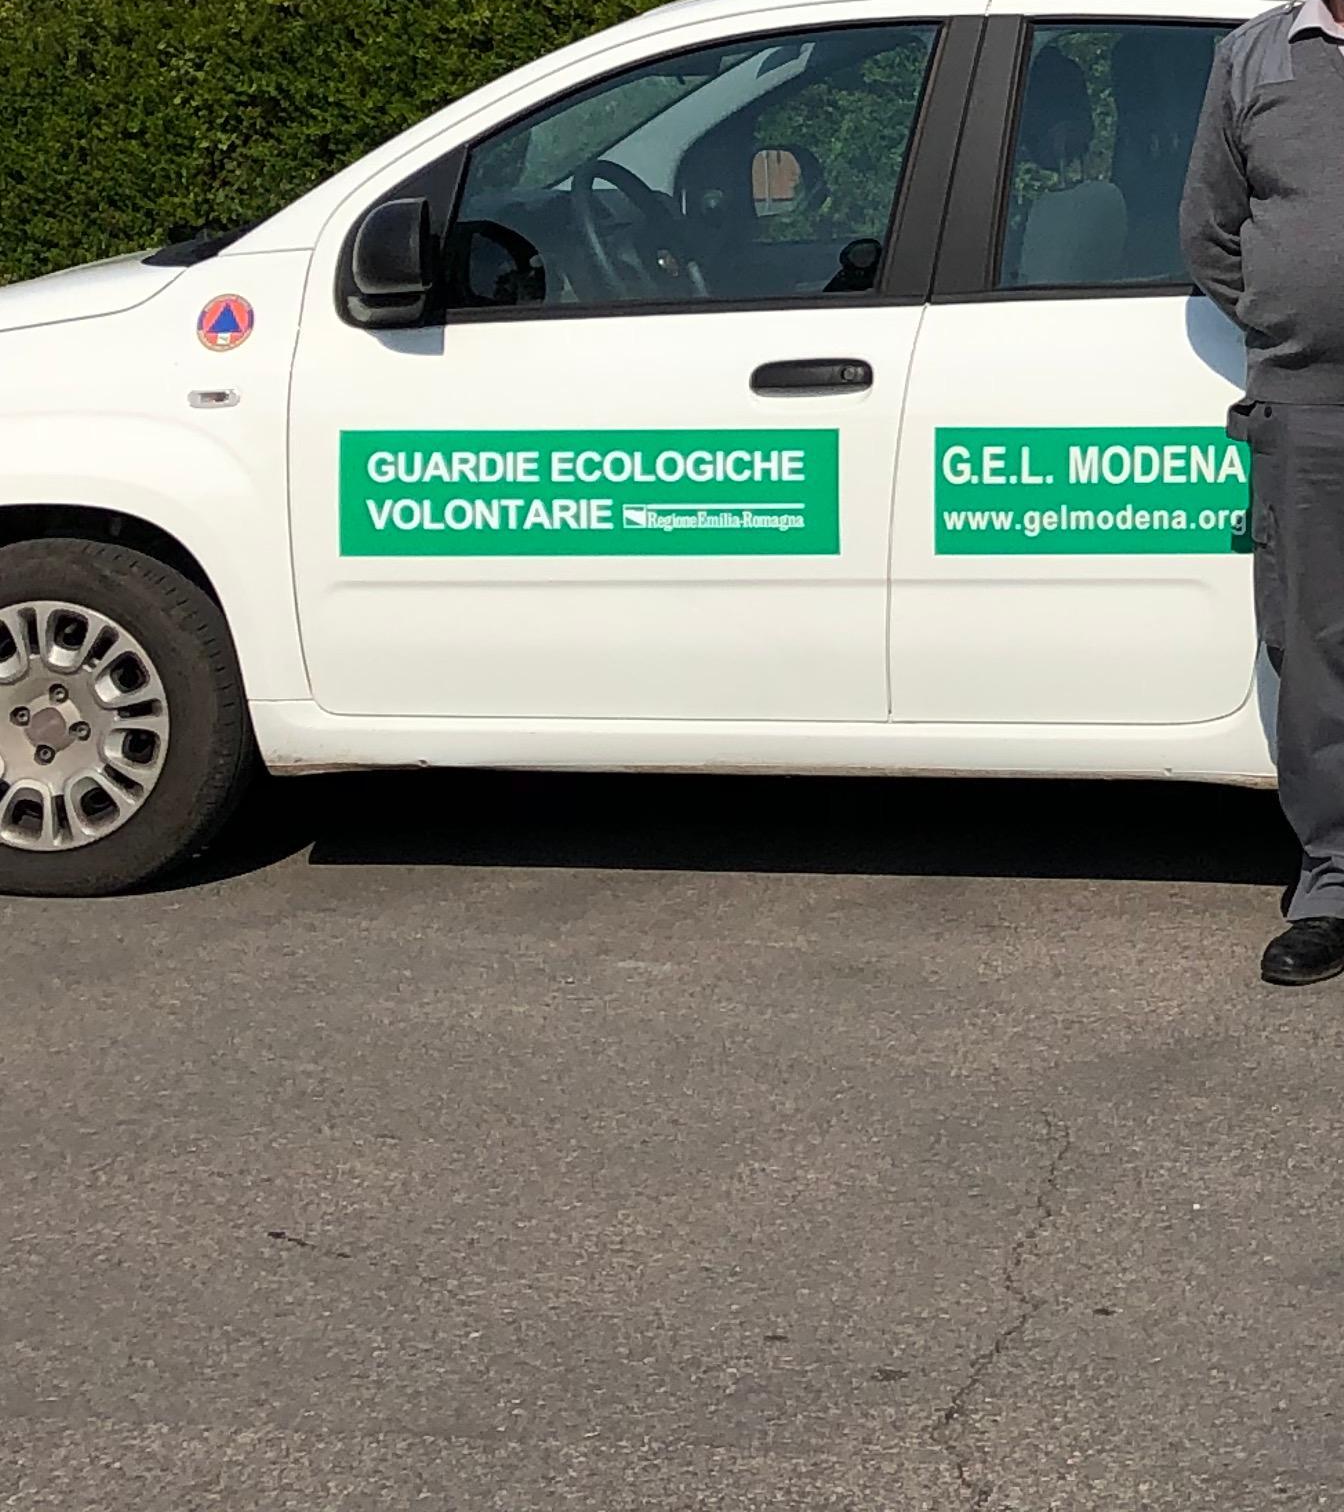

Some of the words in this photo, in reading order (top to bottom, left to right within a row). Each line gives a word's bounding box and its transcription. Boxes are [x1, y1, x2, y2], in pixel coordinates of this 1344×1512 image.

[367, 451, 541, 483] GUARDIE
[551, 450, 806, 483] ECOLOGICHE
[942, 445, 1054, 485] G.E.L.
[1068, 444, 1247, 484] MODENA
[366, 498, 614, 531] VOLONTARIE
[943, 504, 1247, 537] www.gelmodena.org
